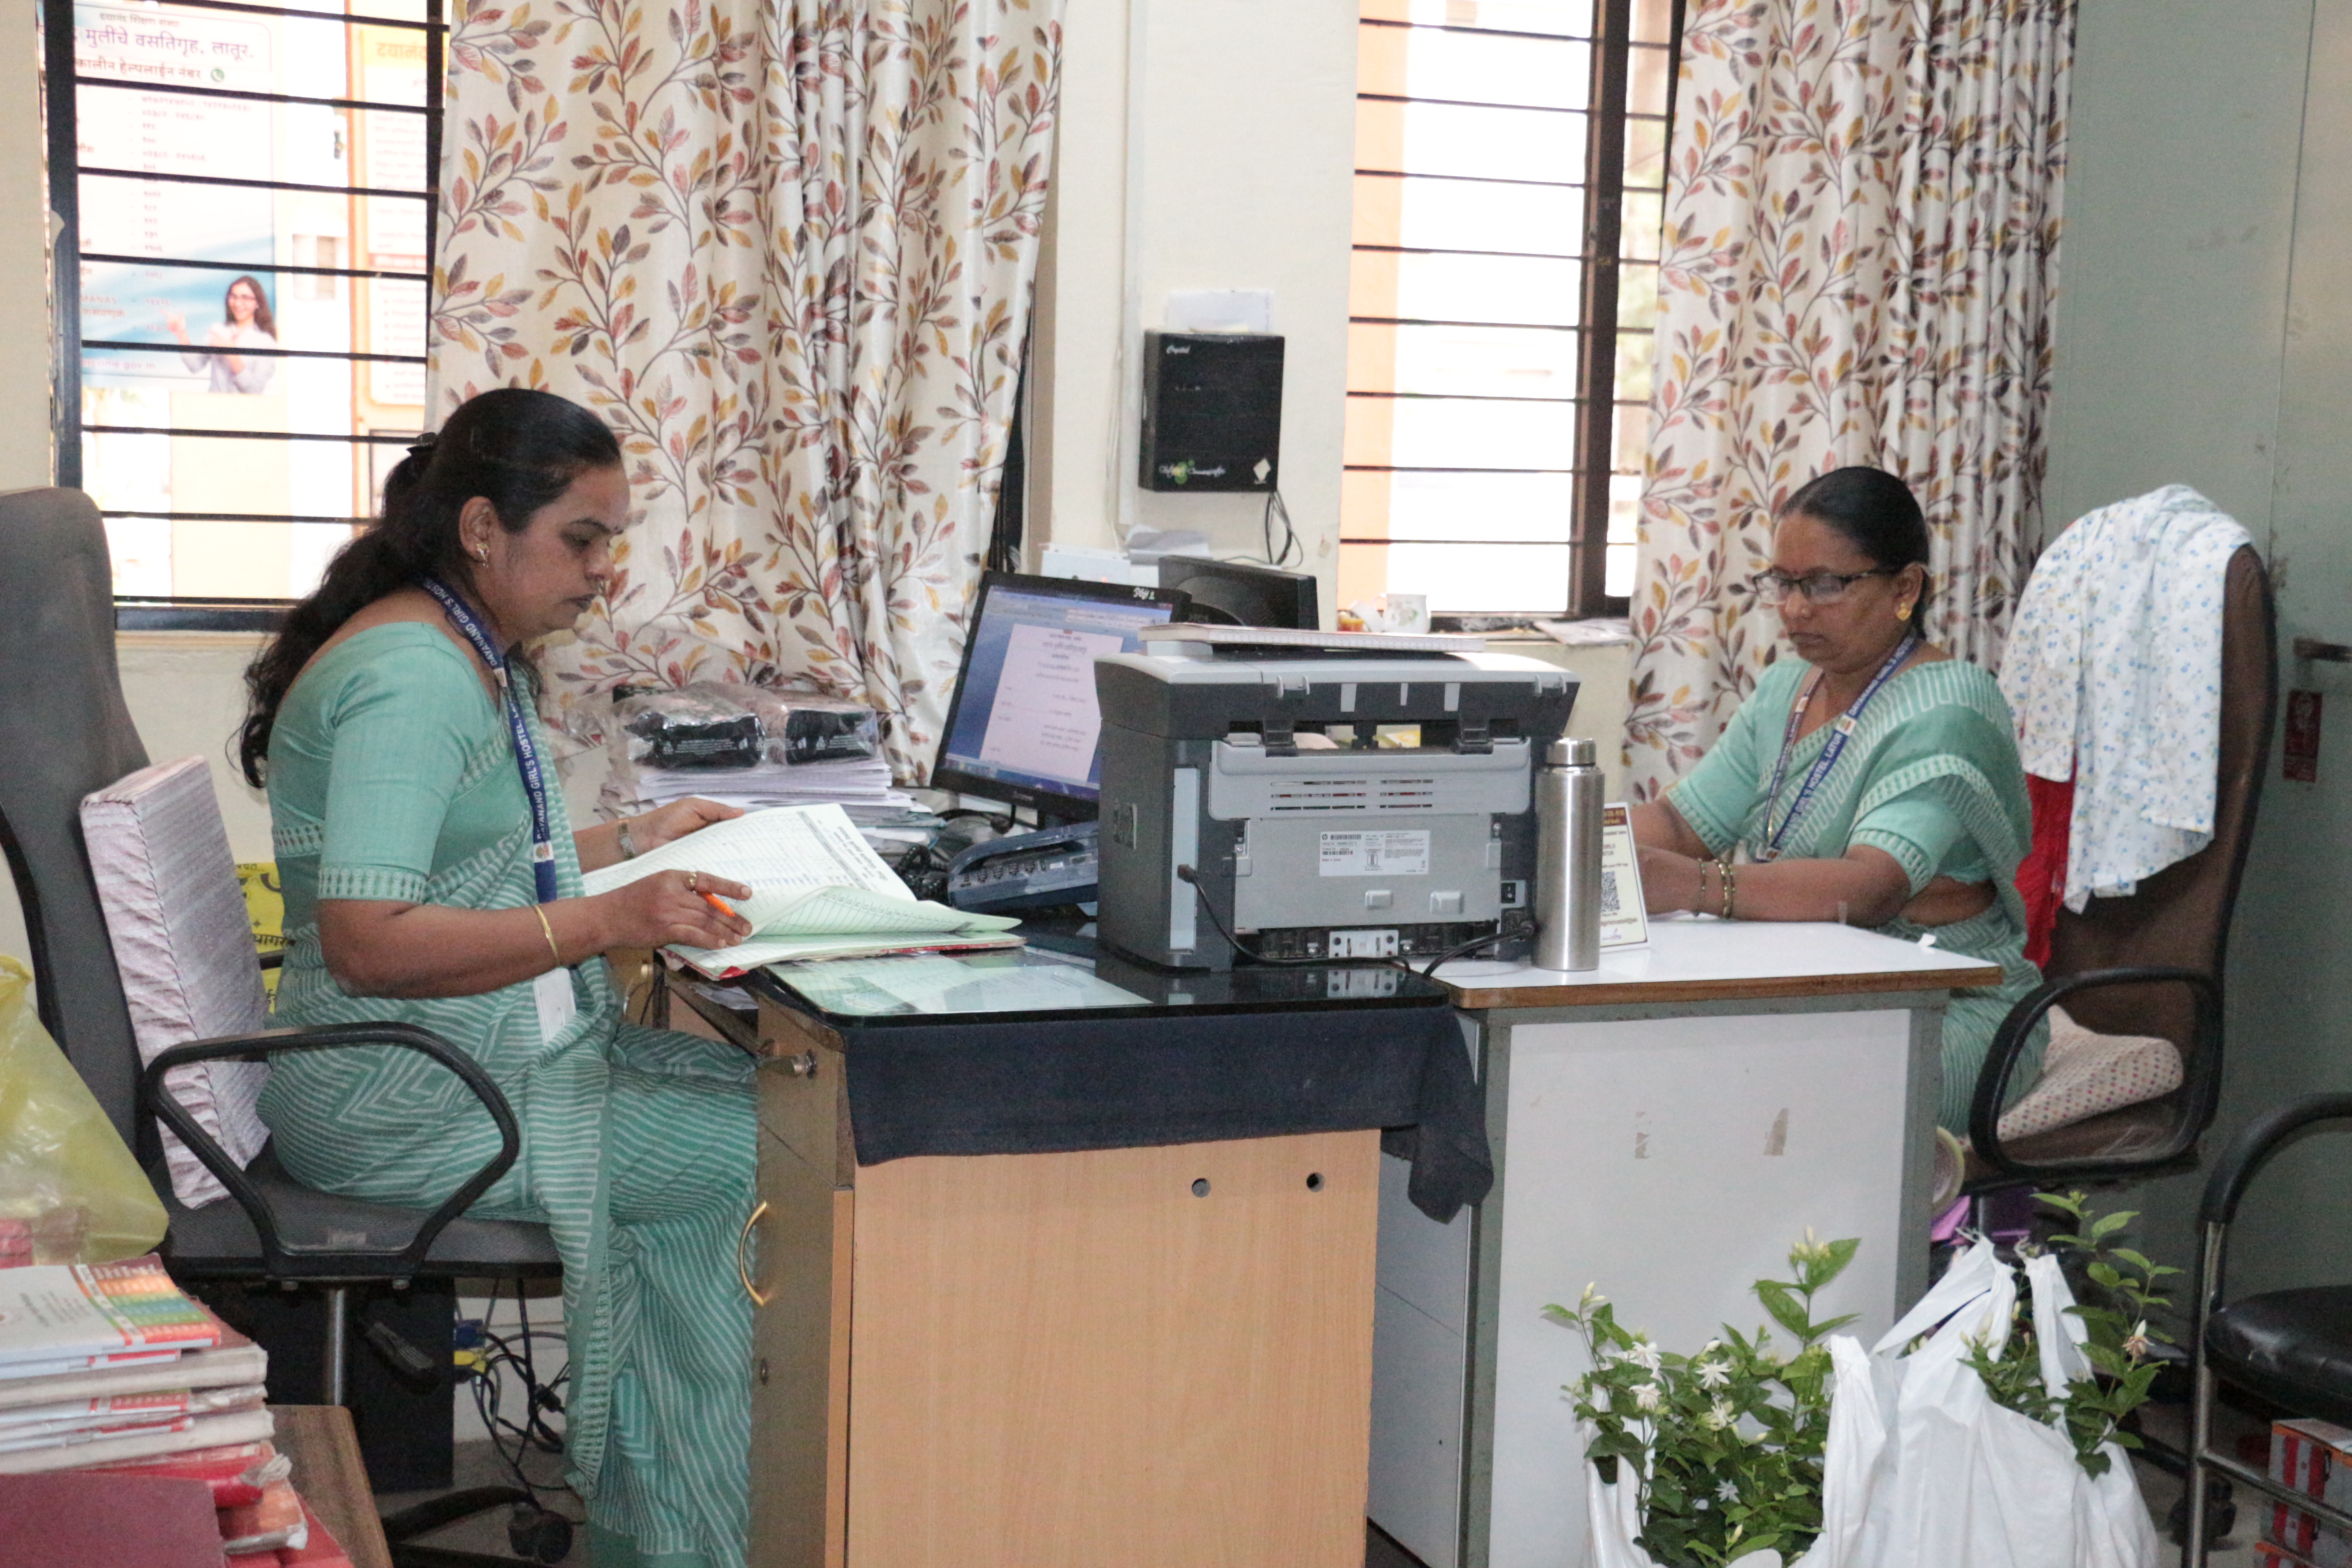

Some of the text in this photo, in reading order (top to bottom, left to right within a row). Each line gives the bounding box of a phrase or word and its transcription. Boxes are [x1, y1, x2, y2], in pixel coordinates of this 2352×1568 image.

[135, 31, 204, 57] वसतिगृह,
[212, 40, 254, 61] लातूर.
[76, 56, 115, 71] कालीन
[82, 359, 156, 371] ercrime.gov.in
[465, 622, 497, 666] DAYANAND
[525, 758, 540, 789] GIRL'S
